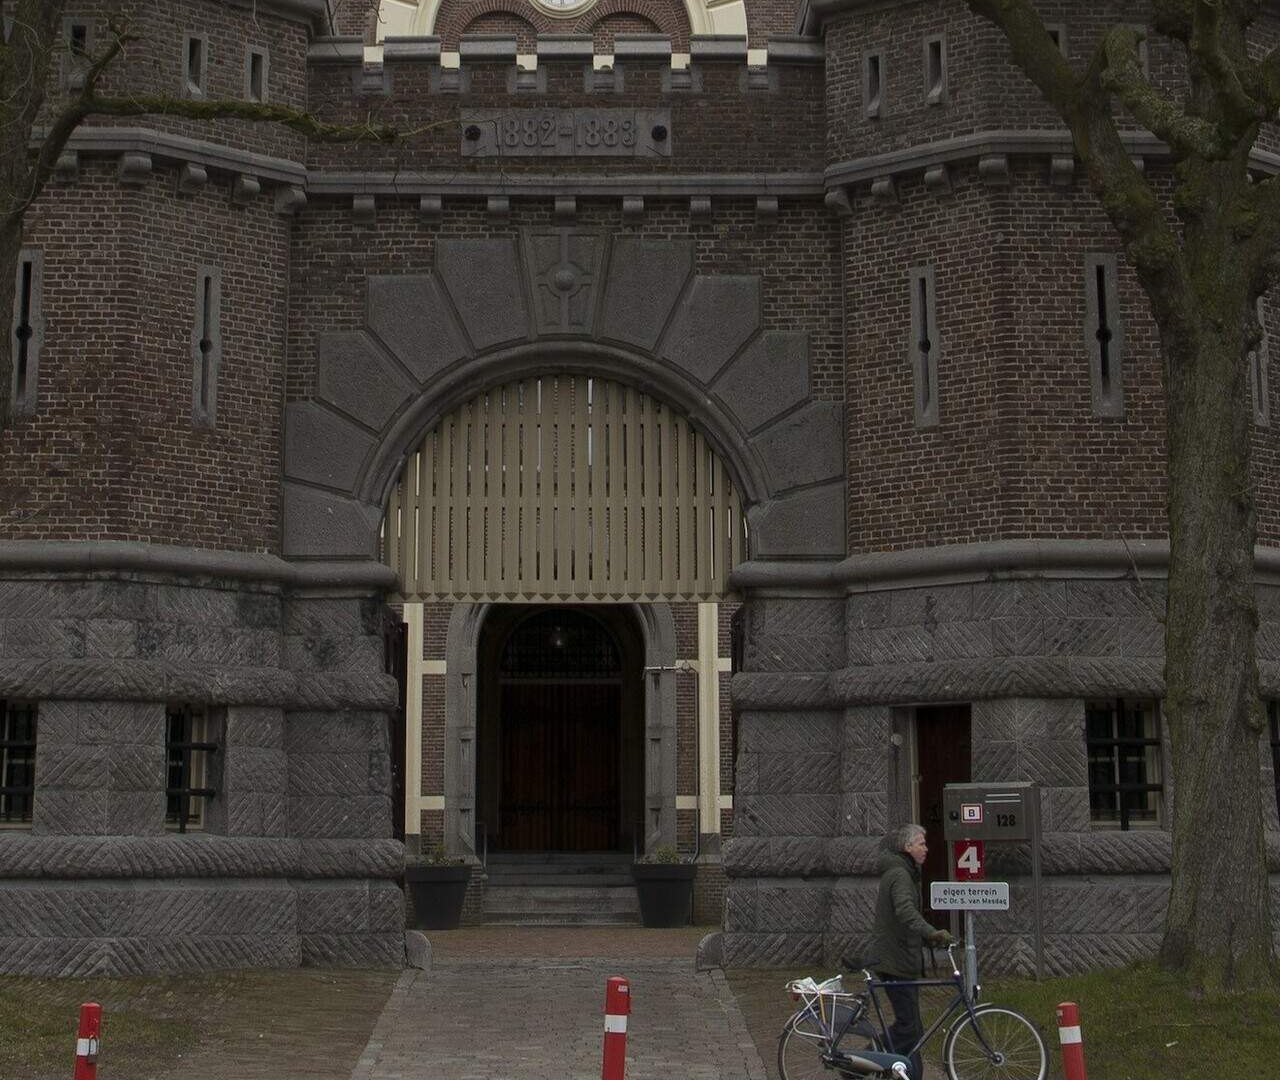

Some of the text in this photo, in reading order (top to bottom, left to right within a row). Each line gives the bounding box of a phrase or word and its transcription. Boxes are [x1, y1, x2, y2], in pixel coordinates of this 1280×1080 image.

[968, 809, 975, 817] B
[996, 814, 1016, 827] 128
[957, 846, 981, 874] 4
[943, 888, 997, 896] eigen terrein
